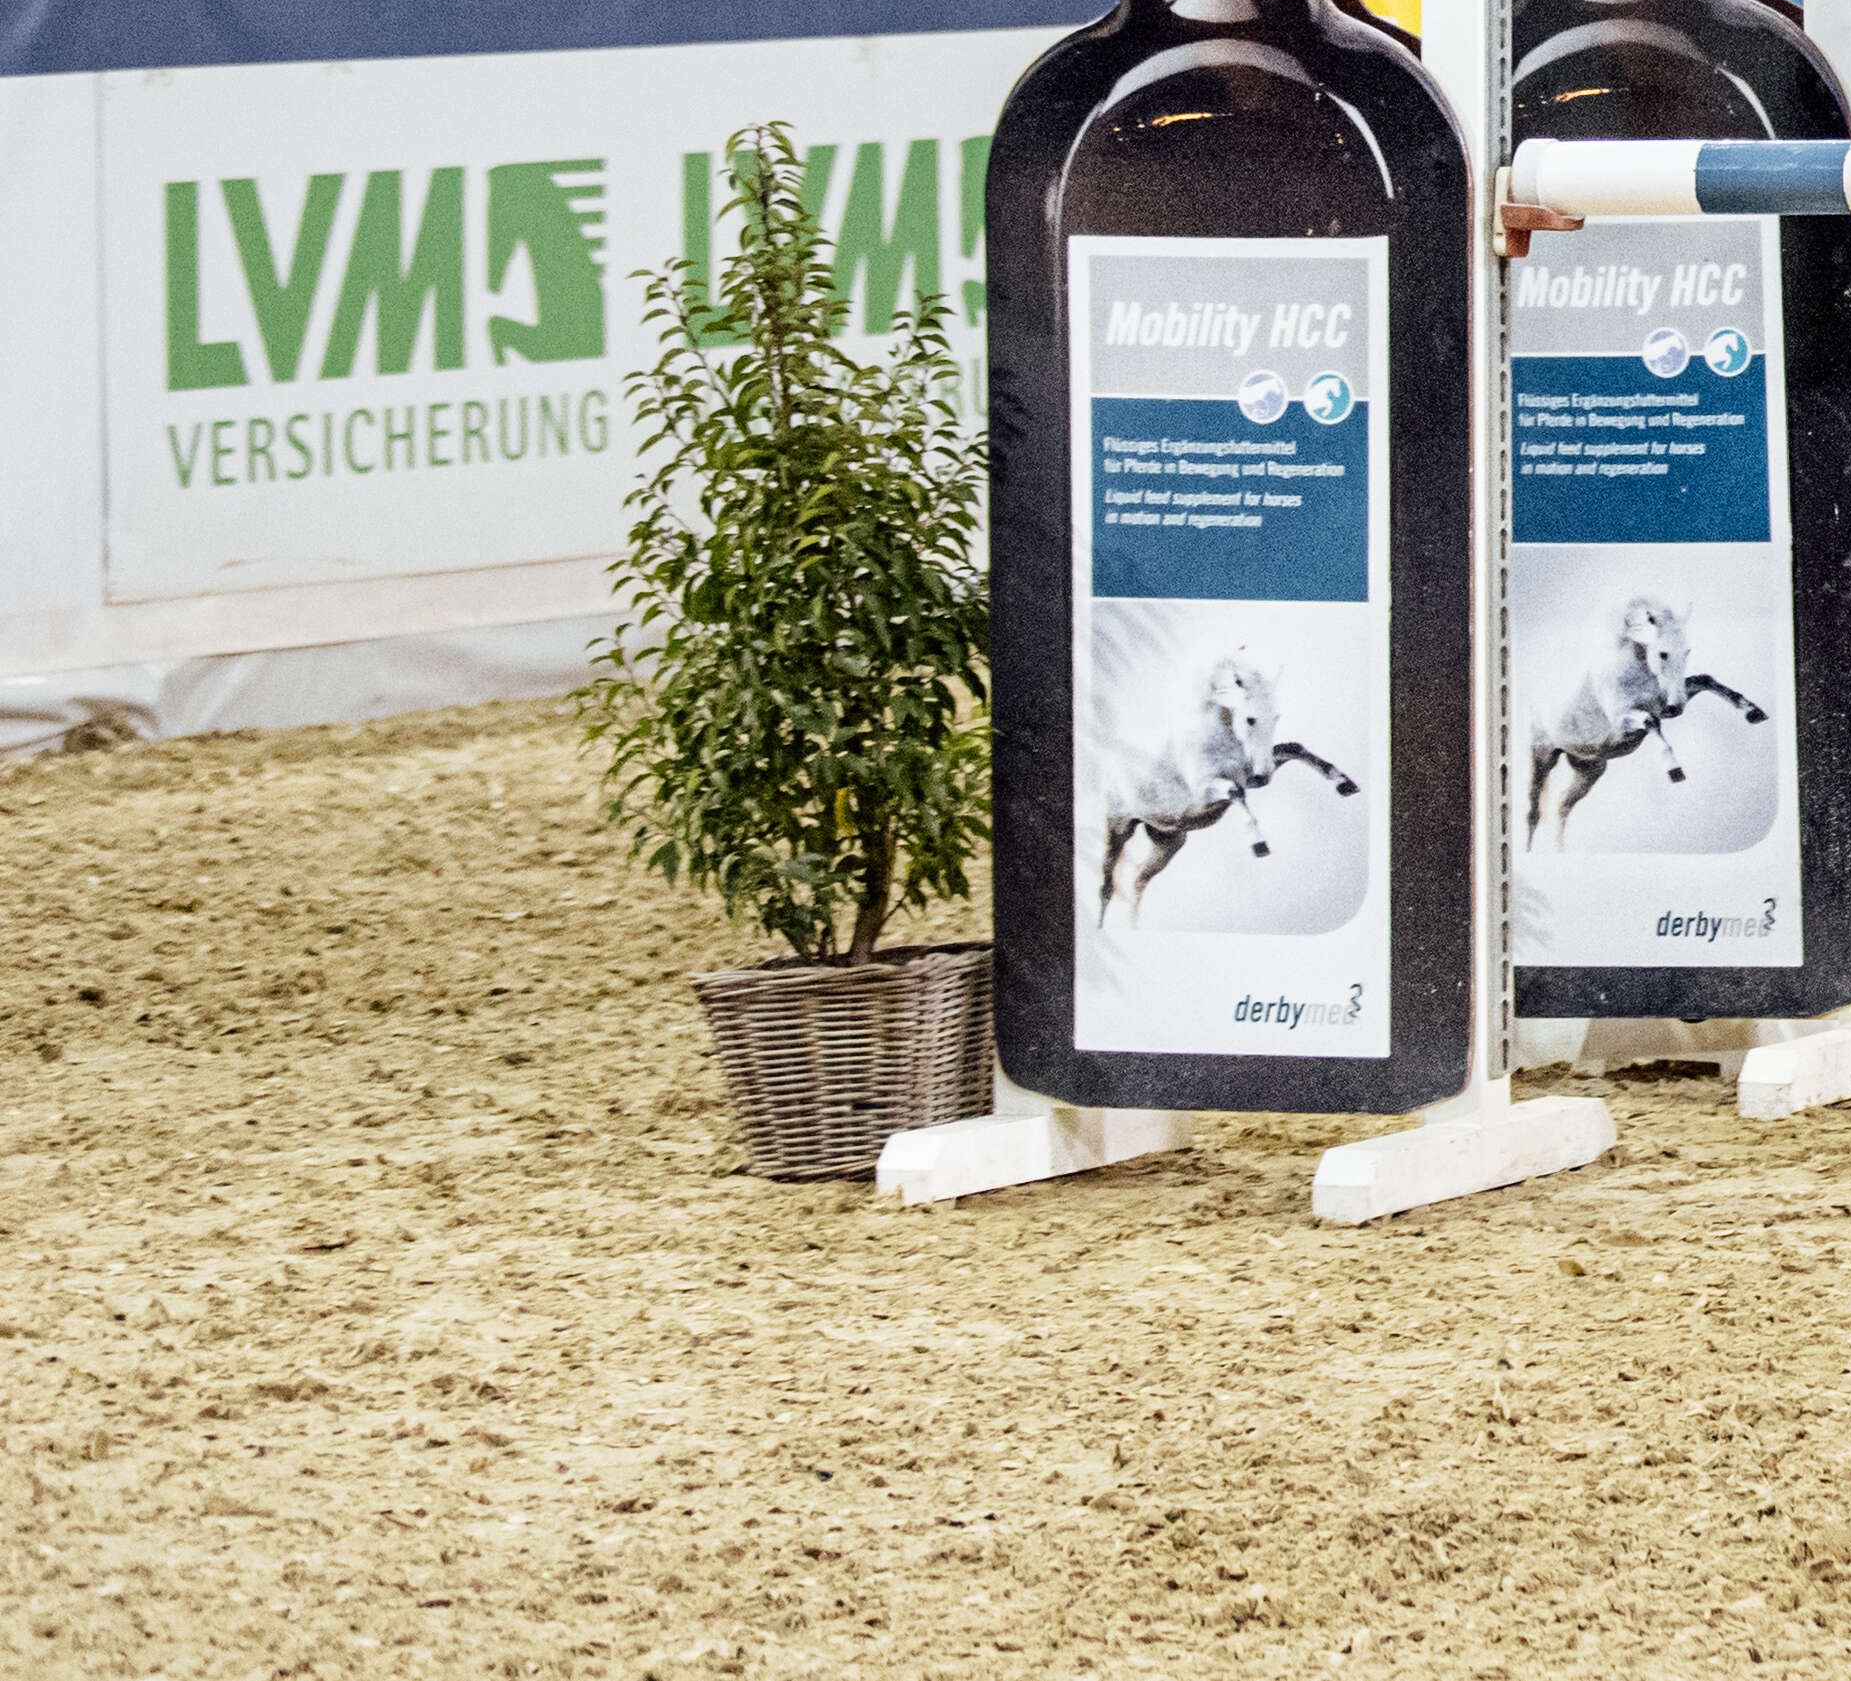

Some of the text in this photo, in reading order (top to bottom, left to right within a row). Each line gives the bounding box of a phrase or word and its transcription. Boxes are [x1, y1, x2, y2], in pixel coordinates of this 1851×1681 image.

[163, 166, 466, 392] LVM
[1518, 263, 1749, 315] Mobility HCC
[1105, 301, 1353, 357] Mobility HCC
[1588, 413, 1646, 430] Bewegung
[1648, 414, 1670, 427] und
[1672, 412, 1746, 428] Regeneration
[167, 391, 610, 489] VERSICHERUNG
[1520, 441, 1706, 458] Liquid feed supplement for horses
[1179, 460, 1240, 479] Bewegung
[1241, 462, 1266, 477] und
[1267, 462, 1346, 479] Regeneration
[1535, 463, 1573, 475] motion
[1575, 462, 1598, 475] and
[1598, 462, 1669, 478] regeneration
[1104, 489, 1302, 508] Liquid feed supplement for horses
[1119, 512, 1160, 525] motion
[1162, 512, 1187, 526] and
[1187, 513, 1263, 529] regeneration
